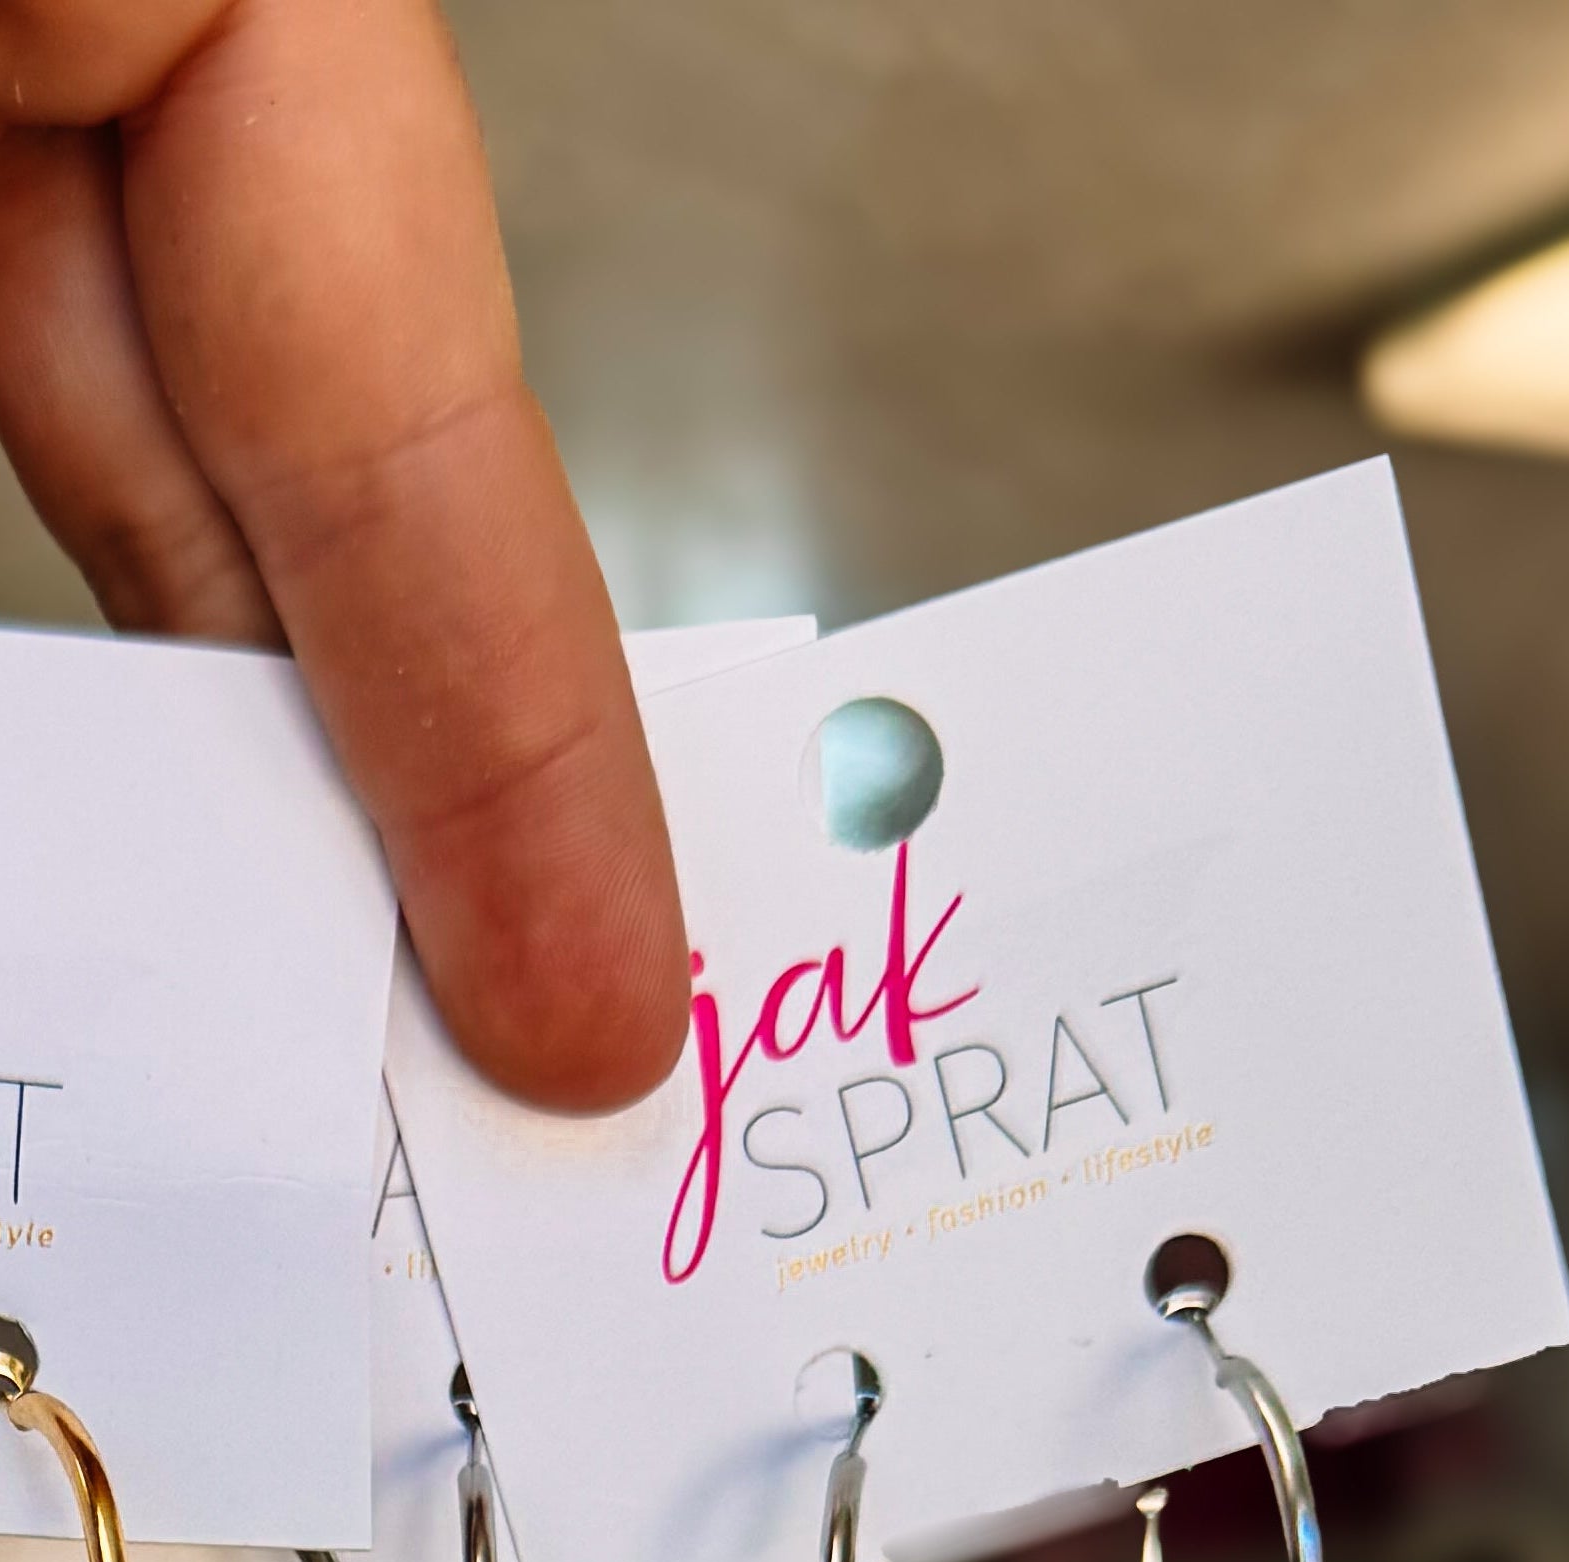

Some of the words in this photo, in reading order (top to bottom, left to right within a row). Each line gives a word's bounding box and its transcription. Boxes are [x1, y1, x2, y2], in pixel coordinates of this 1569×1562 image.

[662, 840, 980, 1284] jak
[743, 976, 1179, 1239] SPRAT
[773, 1226, 892, 1294] jewelry
[926, 1177, 1049, 1239] fashion
[1083, 1120, 1216, 1186] lifestyle
